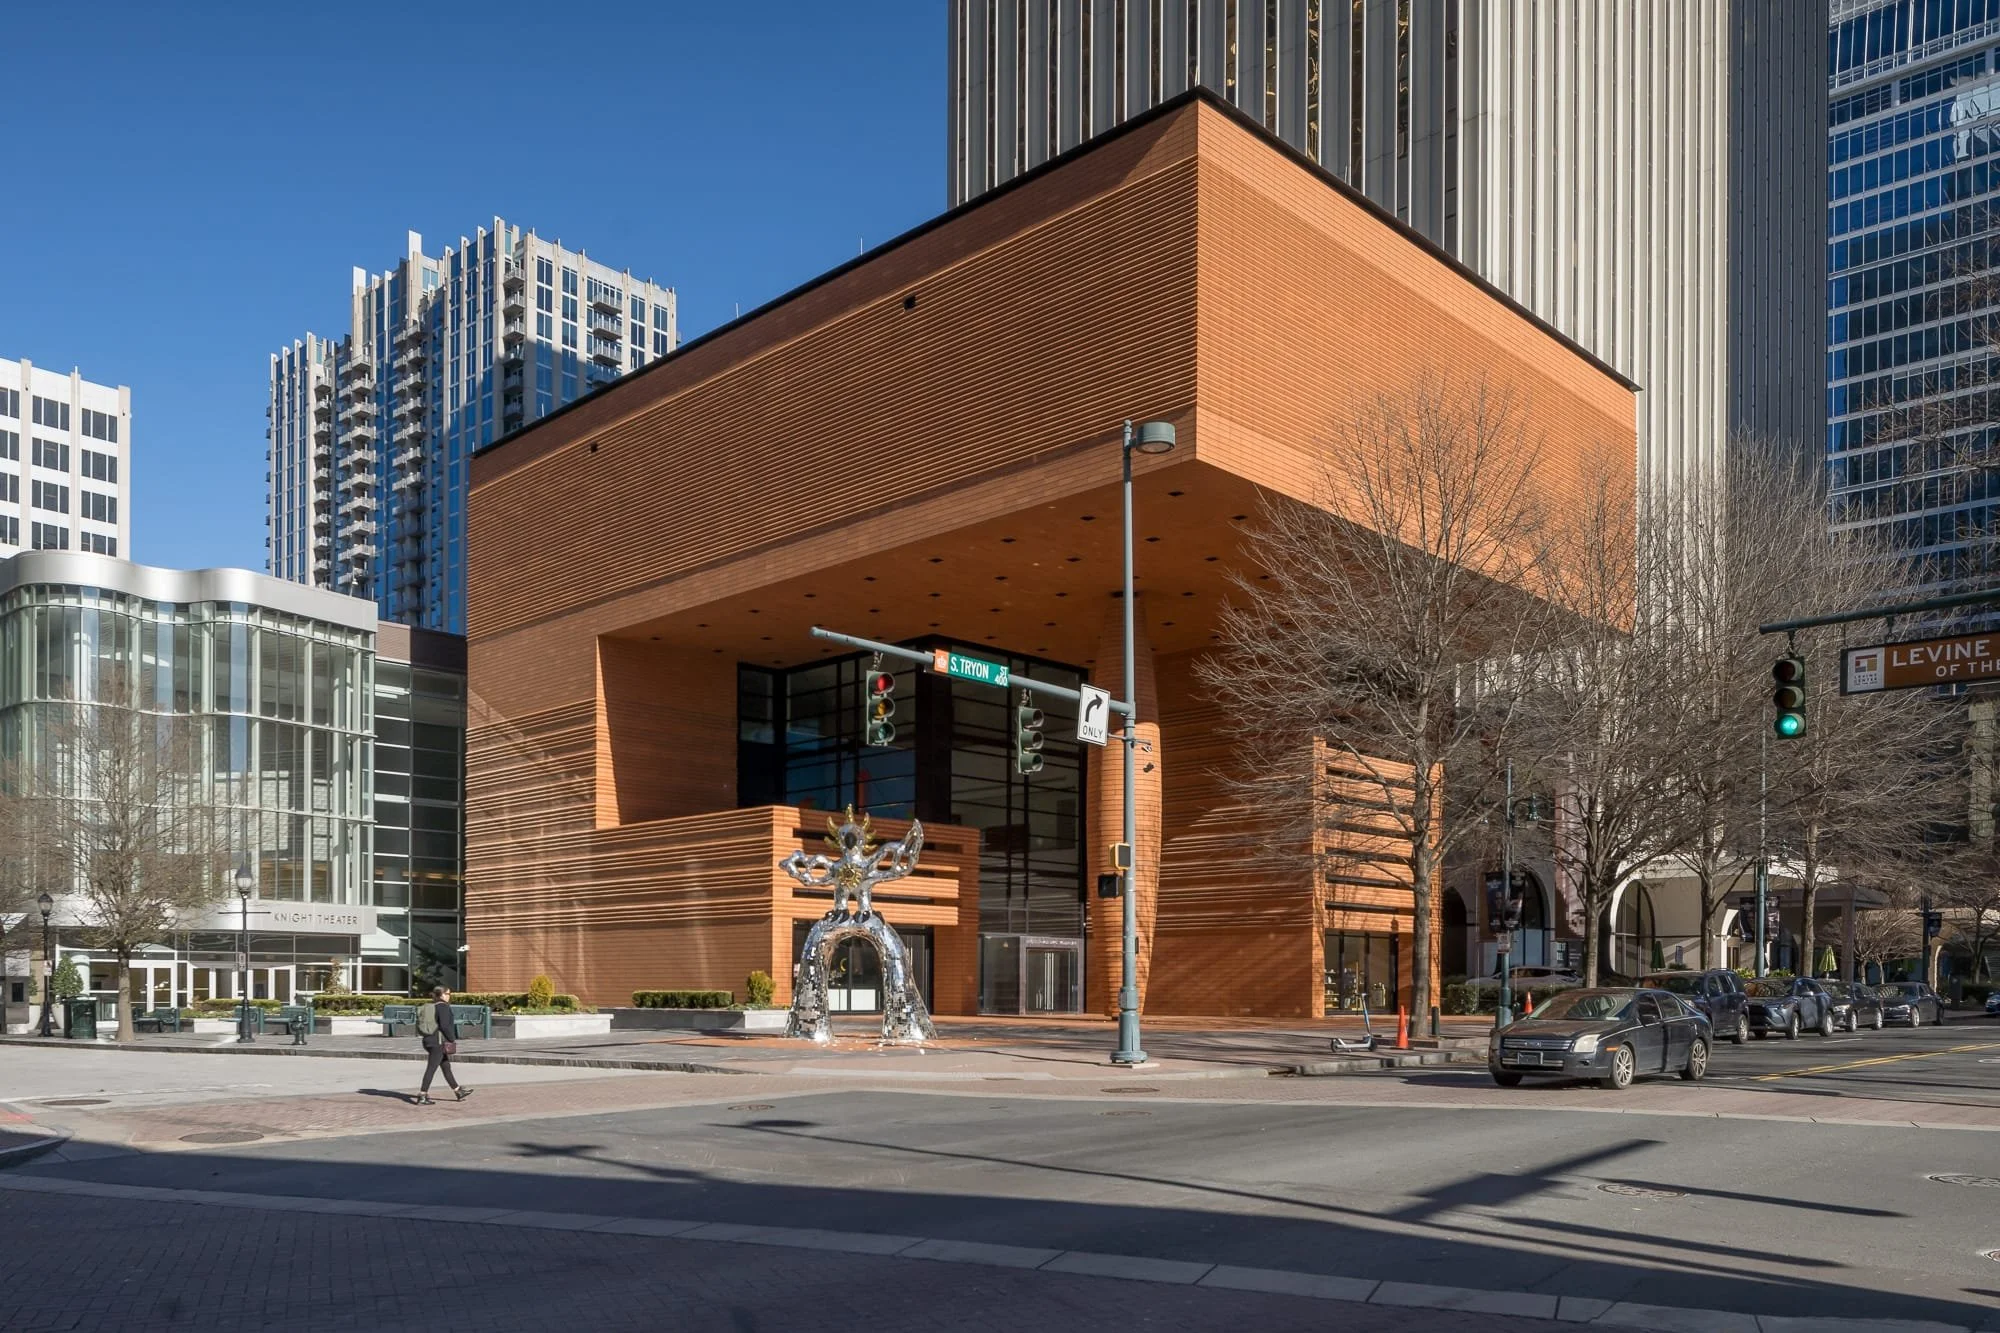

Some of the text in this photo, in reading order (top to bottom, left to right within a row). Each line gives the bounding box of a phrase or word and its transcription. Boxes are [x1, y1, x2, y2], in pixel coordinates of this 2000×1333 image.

[1892, 640, 1990, 667] LEVINE
[950, 656, 1009, 679] S. TRYON ST
[1936, 664, 1960, 677] OF
[994, 674, 1008, 686] 400
[1082, 725, 1103, 738] ONLY
[274, 911, 357, 925] KNIGHT THEATER
